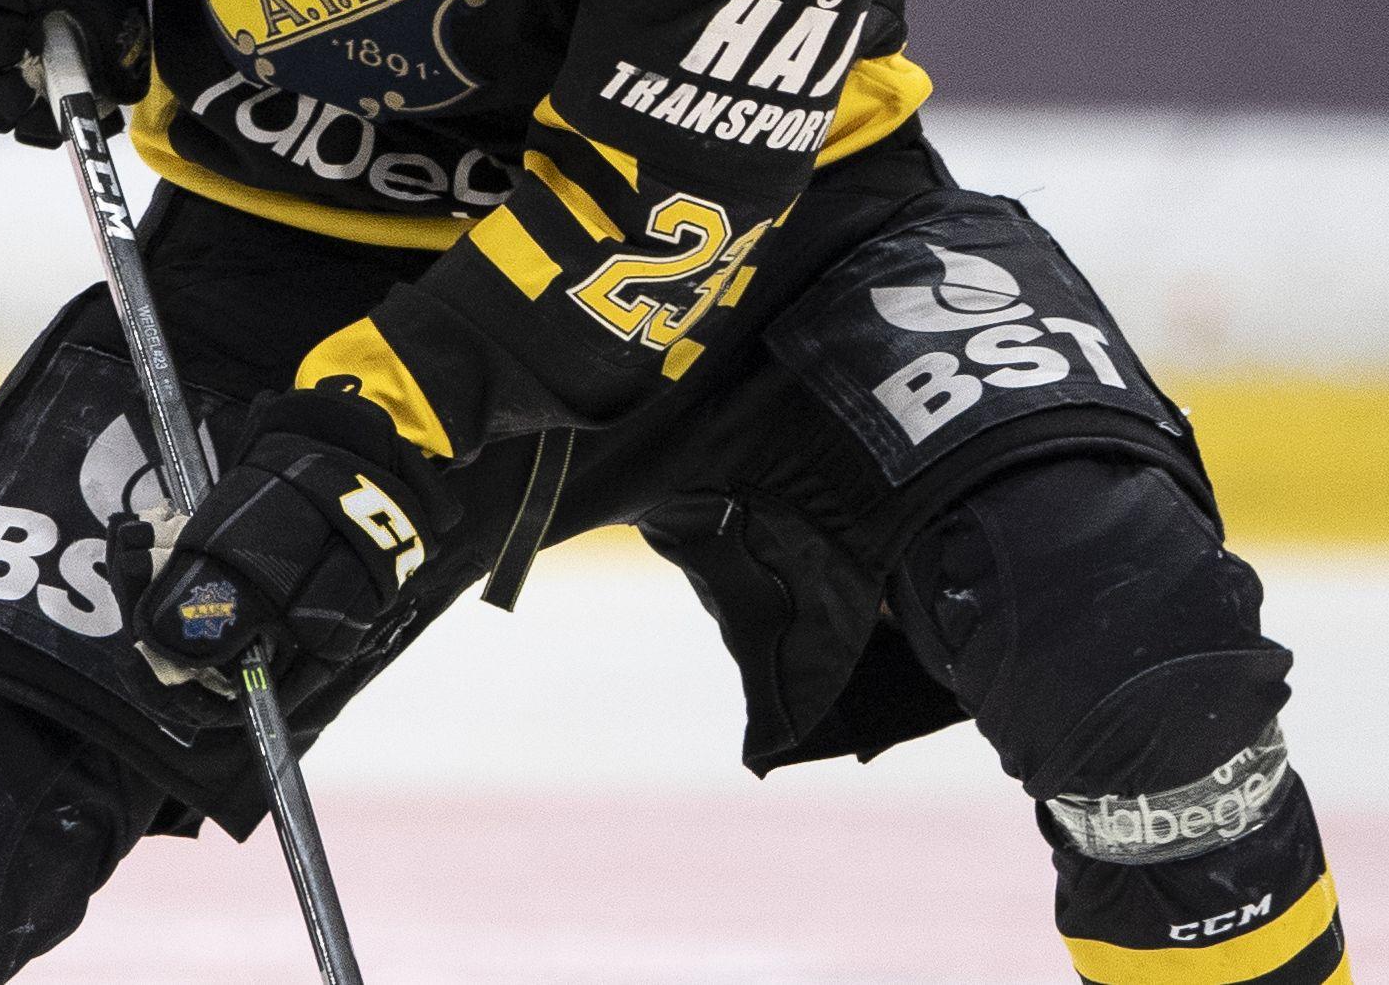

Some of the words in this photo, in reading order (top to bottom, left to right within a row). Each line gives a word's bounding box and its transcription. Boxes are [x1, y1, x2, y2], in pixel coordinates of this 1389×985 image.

[71, 116, 136, 241] CCM
[872, 317, 1127, 446] BST
[1169, 894, 1273, 940] CCM
